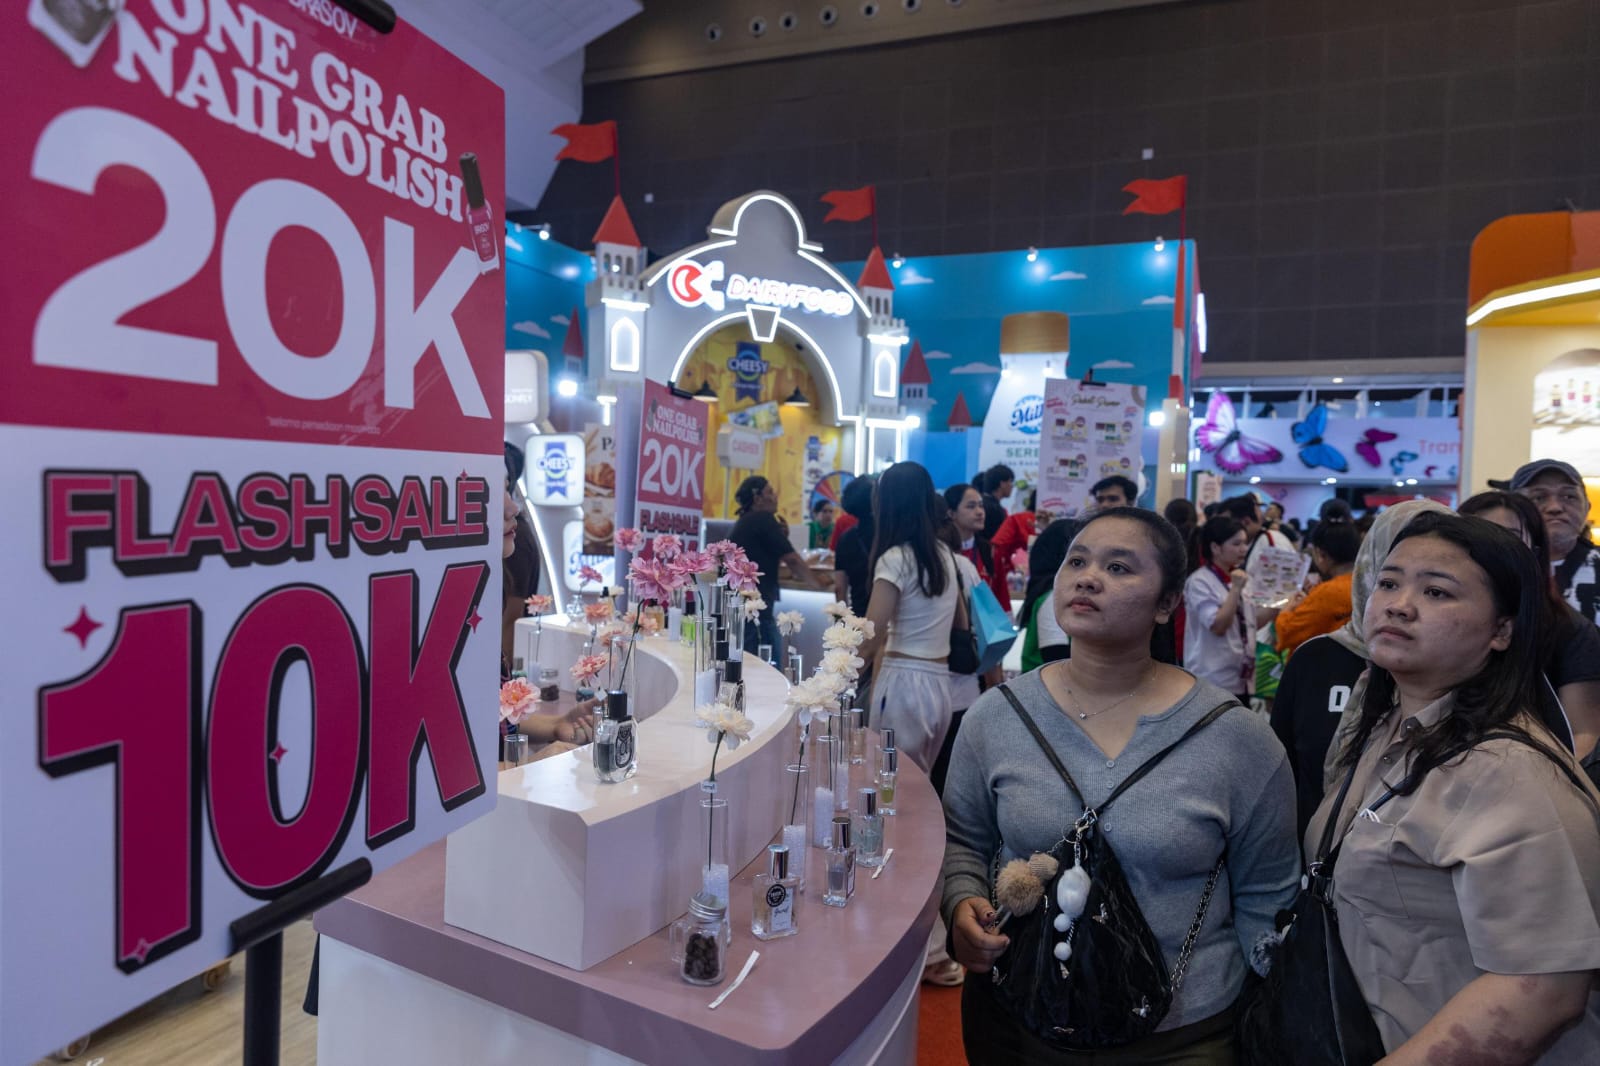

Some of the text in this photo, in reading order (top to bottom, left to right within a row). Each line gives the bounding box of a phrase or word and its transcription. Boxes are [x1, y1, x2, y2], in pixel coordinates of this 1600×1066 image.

[112, 8, 464, 223] NAILPOLISH
[310, 51, 449, 164] GRAB
[32, 105, 494, 420] 20K
[656, 405, 675, 423] ONE
[728, 358, 768, 374] CHEESY
[640, 437, 705, 500] 20K
[37, 559, 491, 976] 10K
